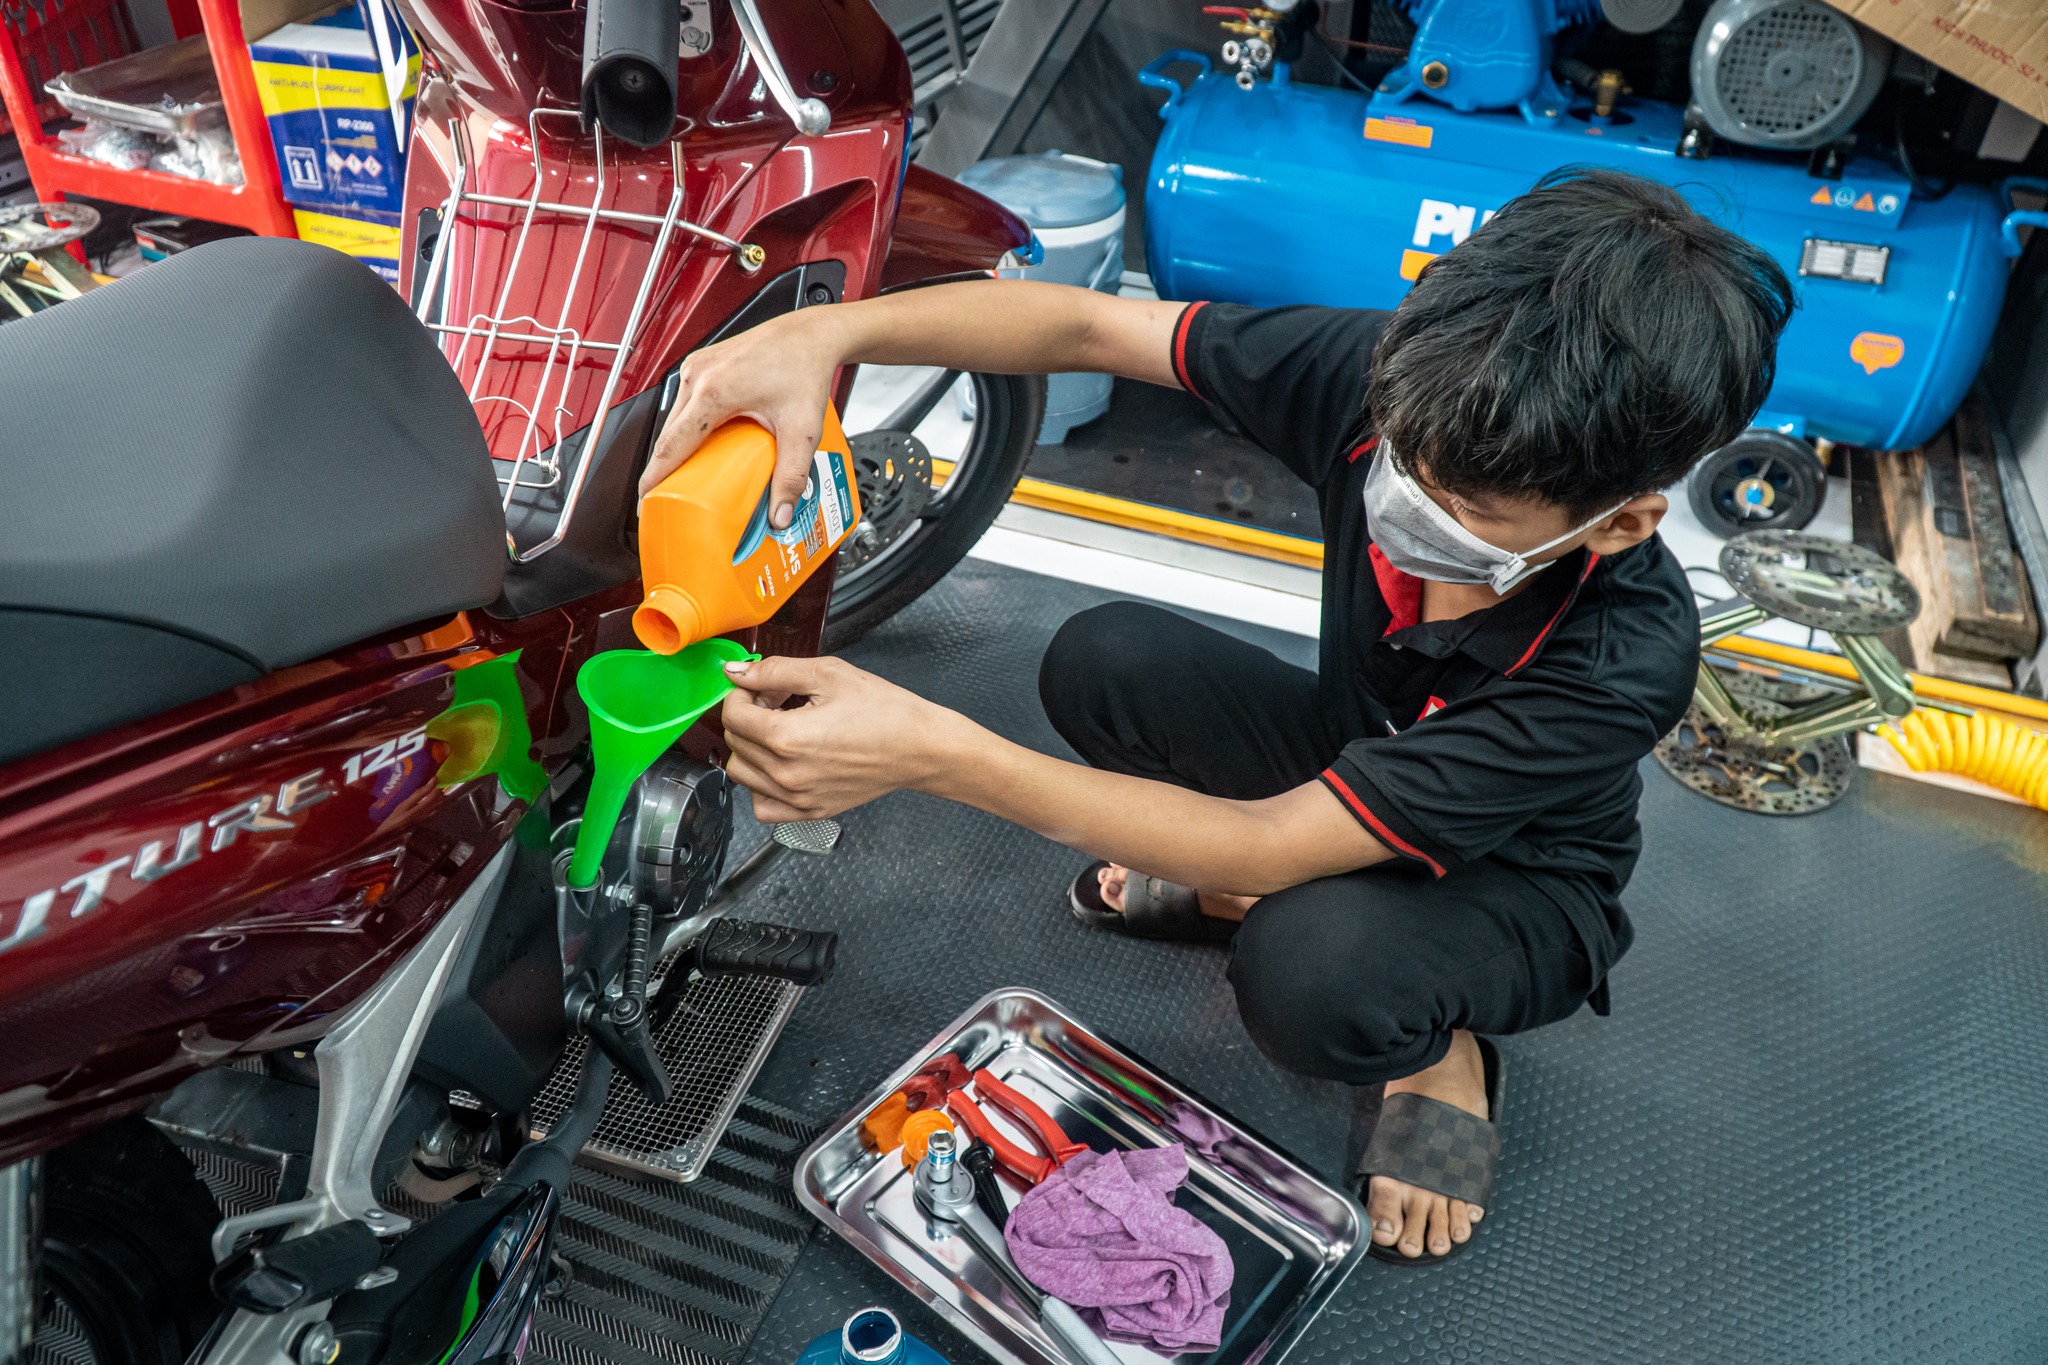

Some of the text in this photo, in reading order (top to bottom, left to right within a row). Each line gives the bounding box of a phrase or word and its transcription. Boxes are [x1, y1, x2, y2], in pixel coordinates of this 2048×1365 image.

[1412, 198, 1497, 248] PU
[824, 479, 841, 533] 10W-40
[783, 526, 801, 576] SMA
[765, 564, 775, 596] REPSOL
[342, 725, 427, 785] 125
